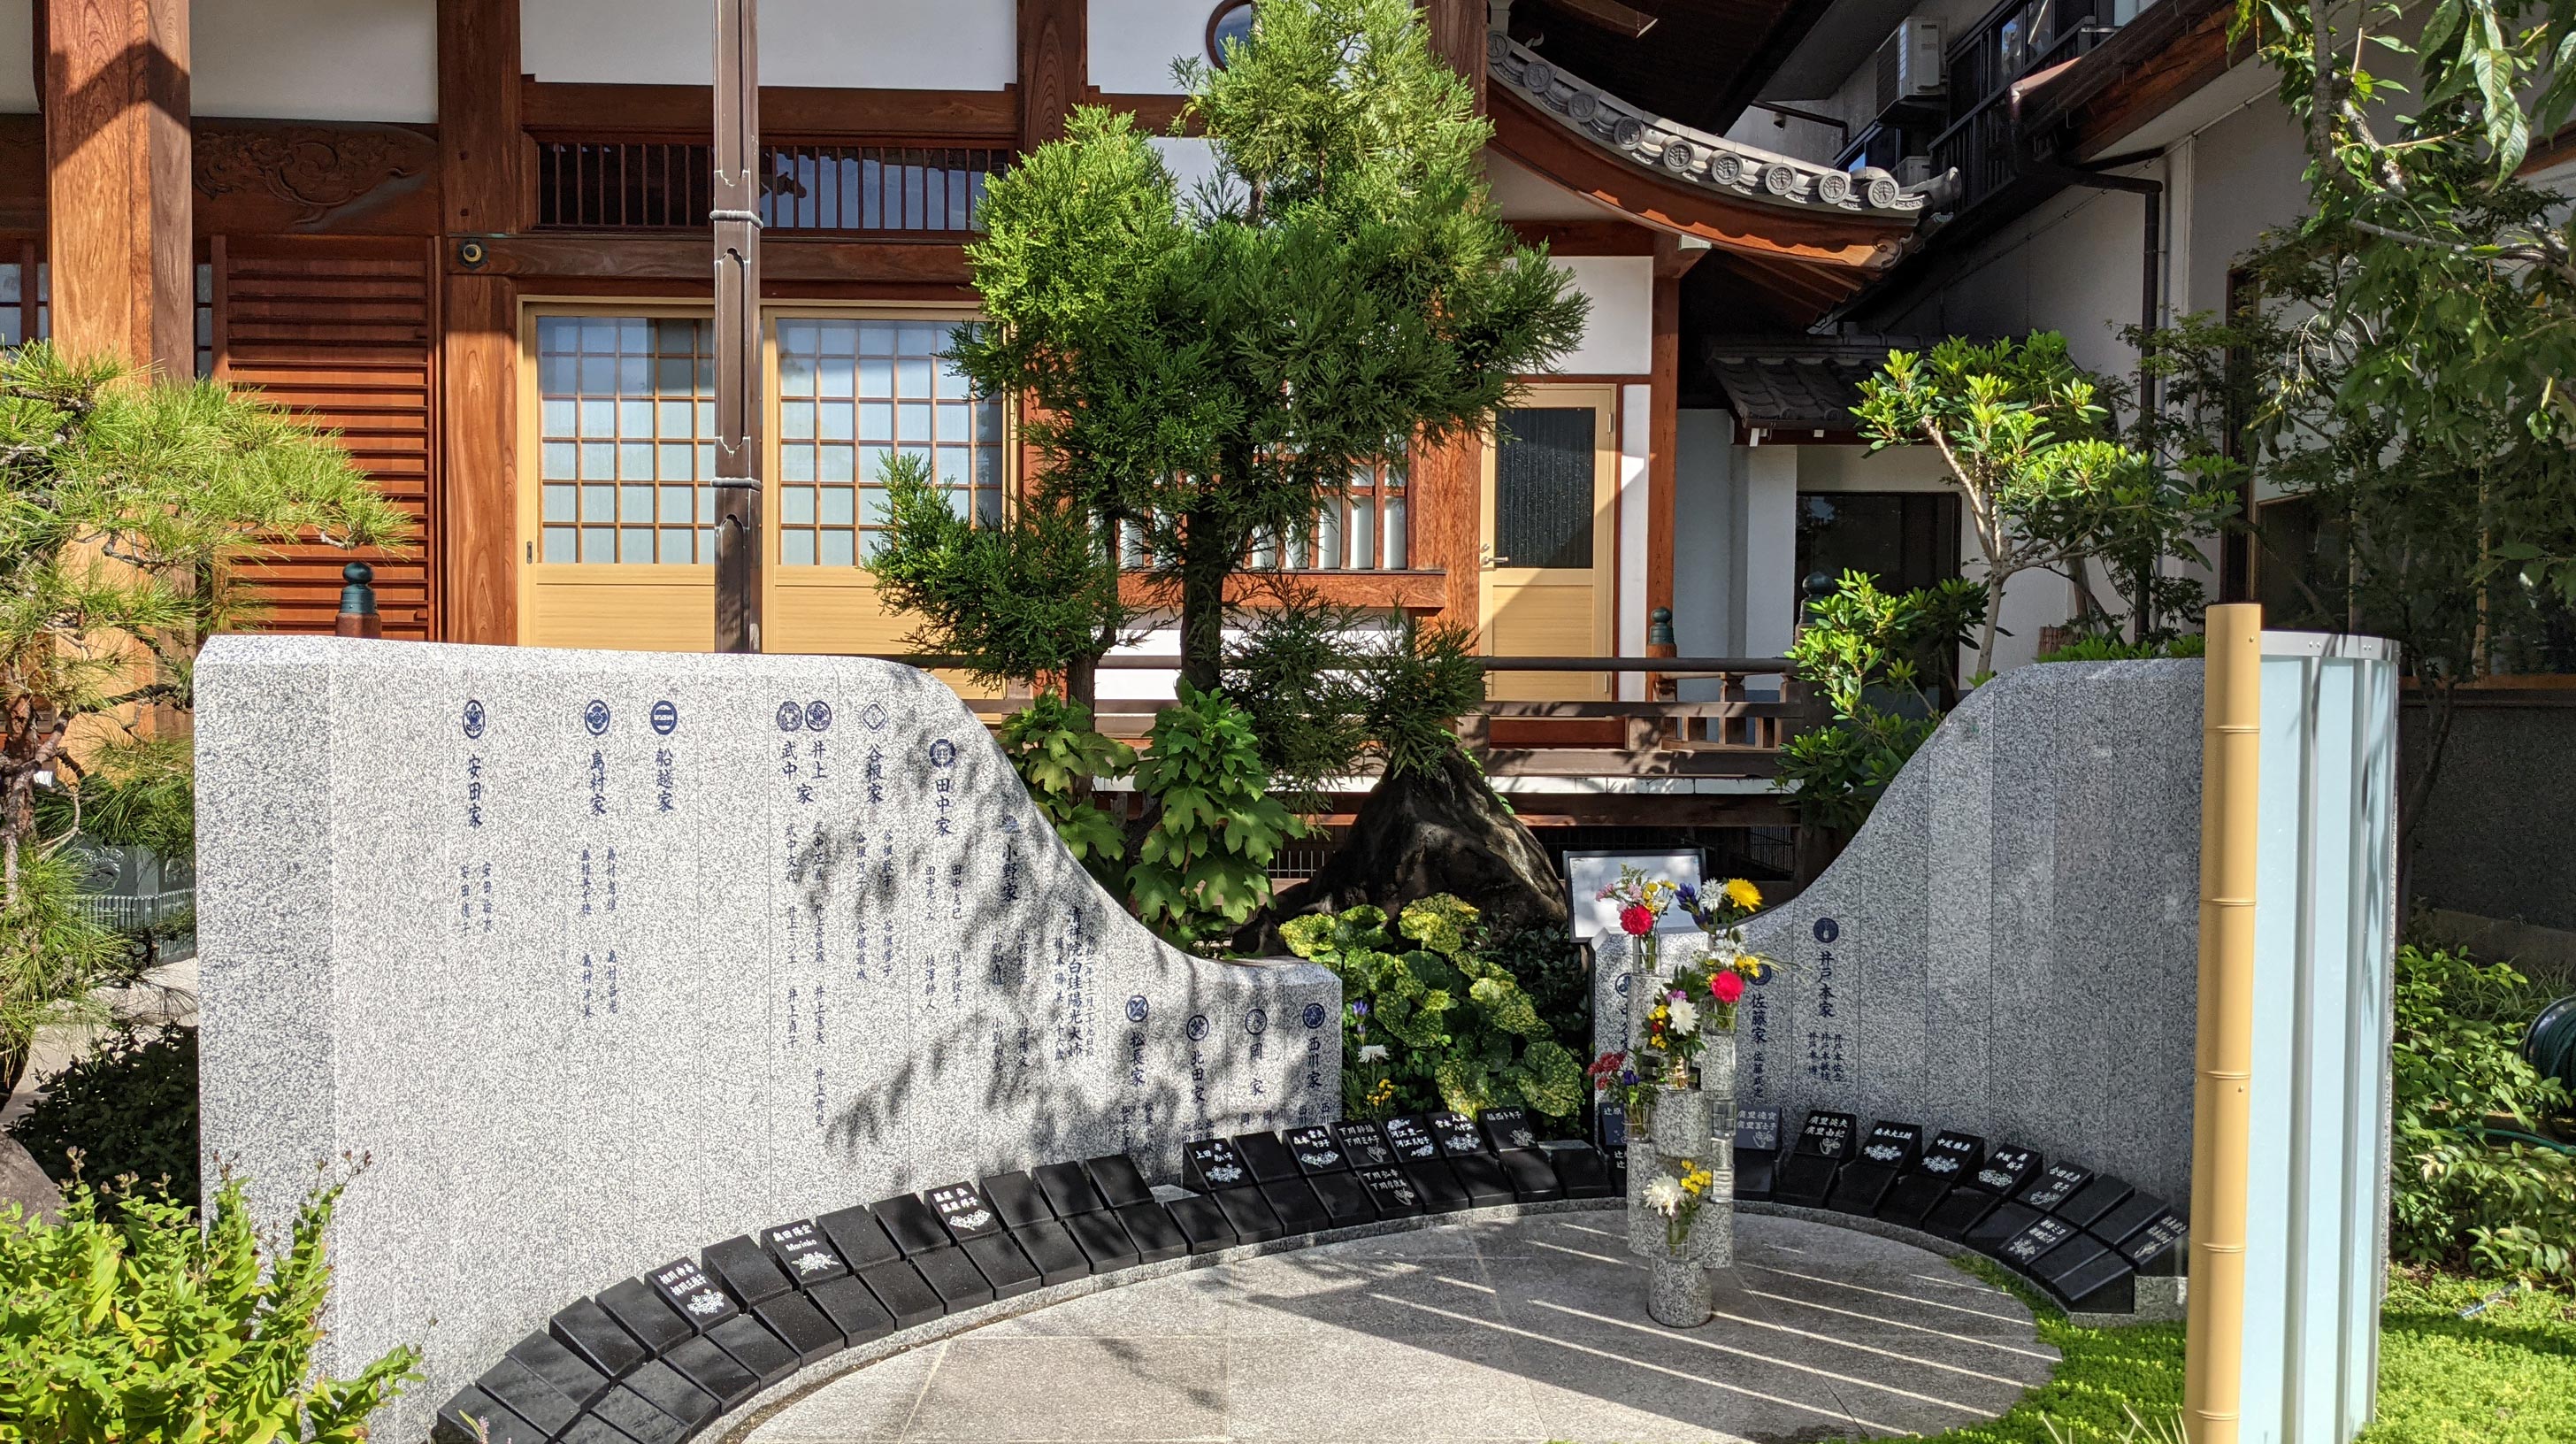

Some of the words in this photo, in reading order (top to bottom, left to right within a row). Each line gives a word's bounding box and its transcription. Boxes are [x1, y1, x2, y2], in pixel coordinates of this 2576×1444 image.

[589, 749, 607, 817] 島村家
[656, 748, 674, 812] 船越家
[779, 740, 799, 780] 武中
[809, 740, 828, 780] 井上
[865, 741, 885, 804] 谷根家
[466, 753, 484, 829] 安田家
[795, 782, 816, 805] 家
[933, 777, 954, 838] 田中家
[1000, 844, 1020, 903] 小野家
[1818, 950, 1836, 1018] 井戸本家
[1751, 993, 1767, 1044] 佐藤家
[1129, 1032, 1145, 1087] 松長家
[1191, 1050, 1206, 1103] 北田家
[1307, 1036, 1322, 1089] 西川家
[785, 1239, 817, 1252] Marinko
